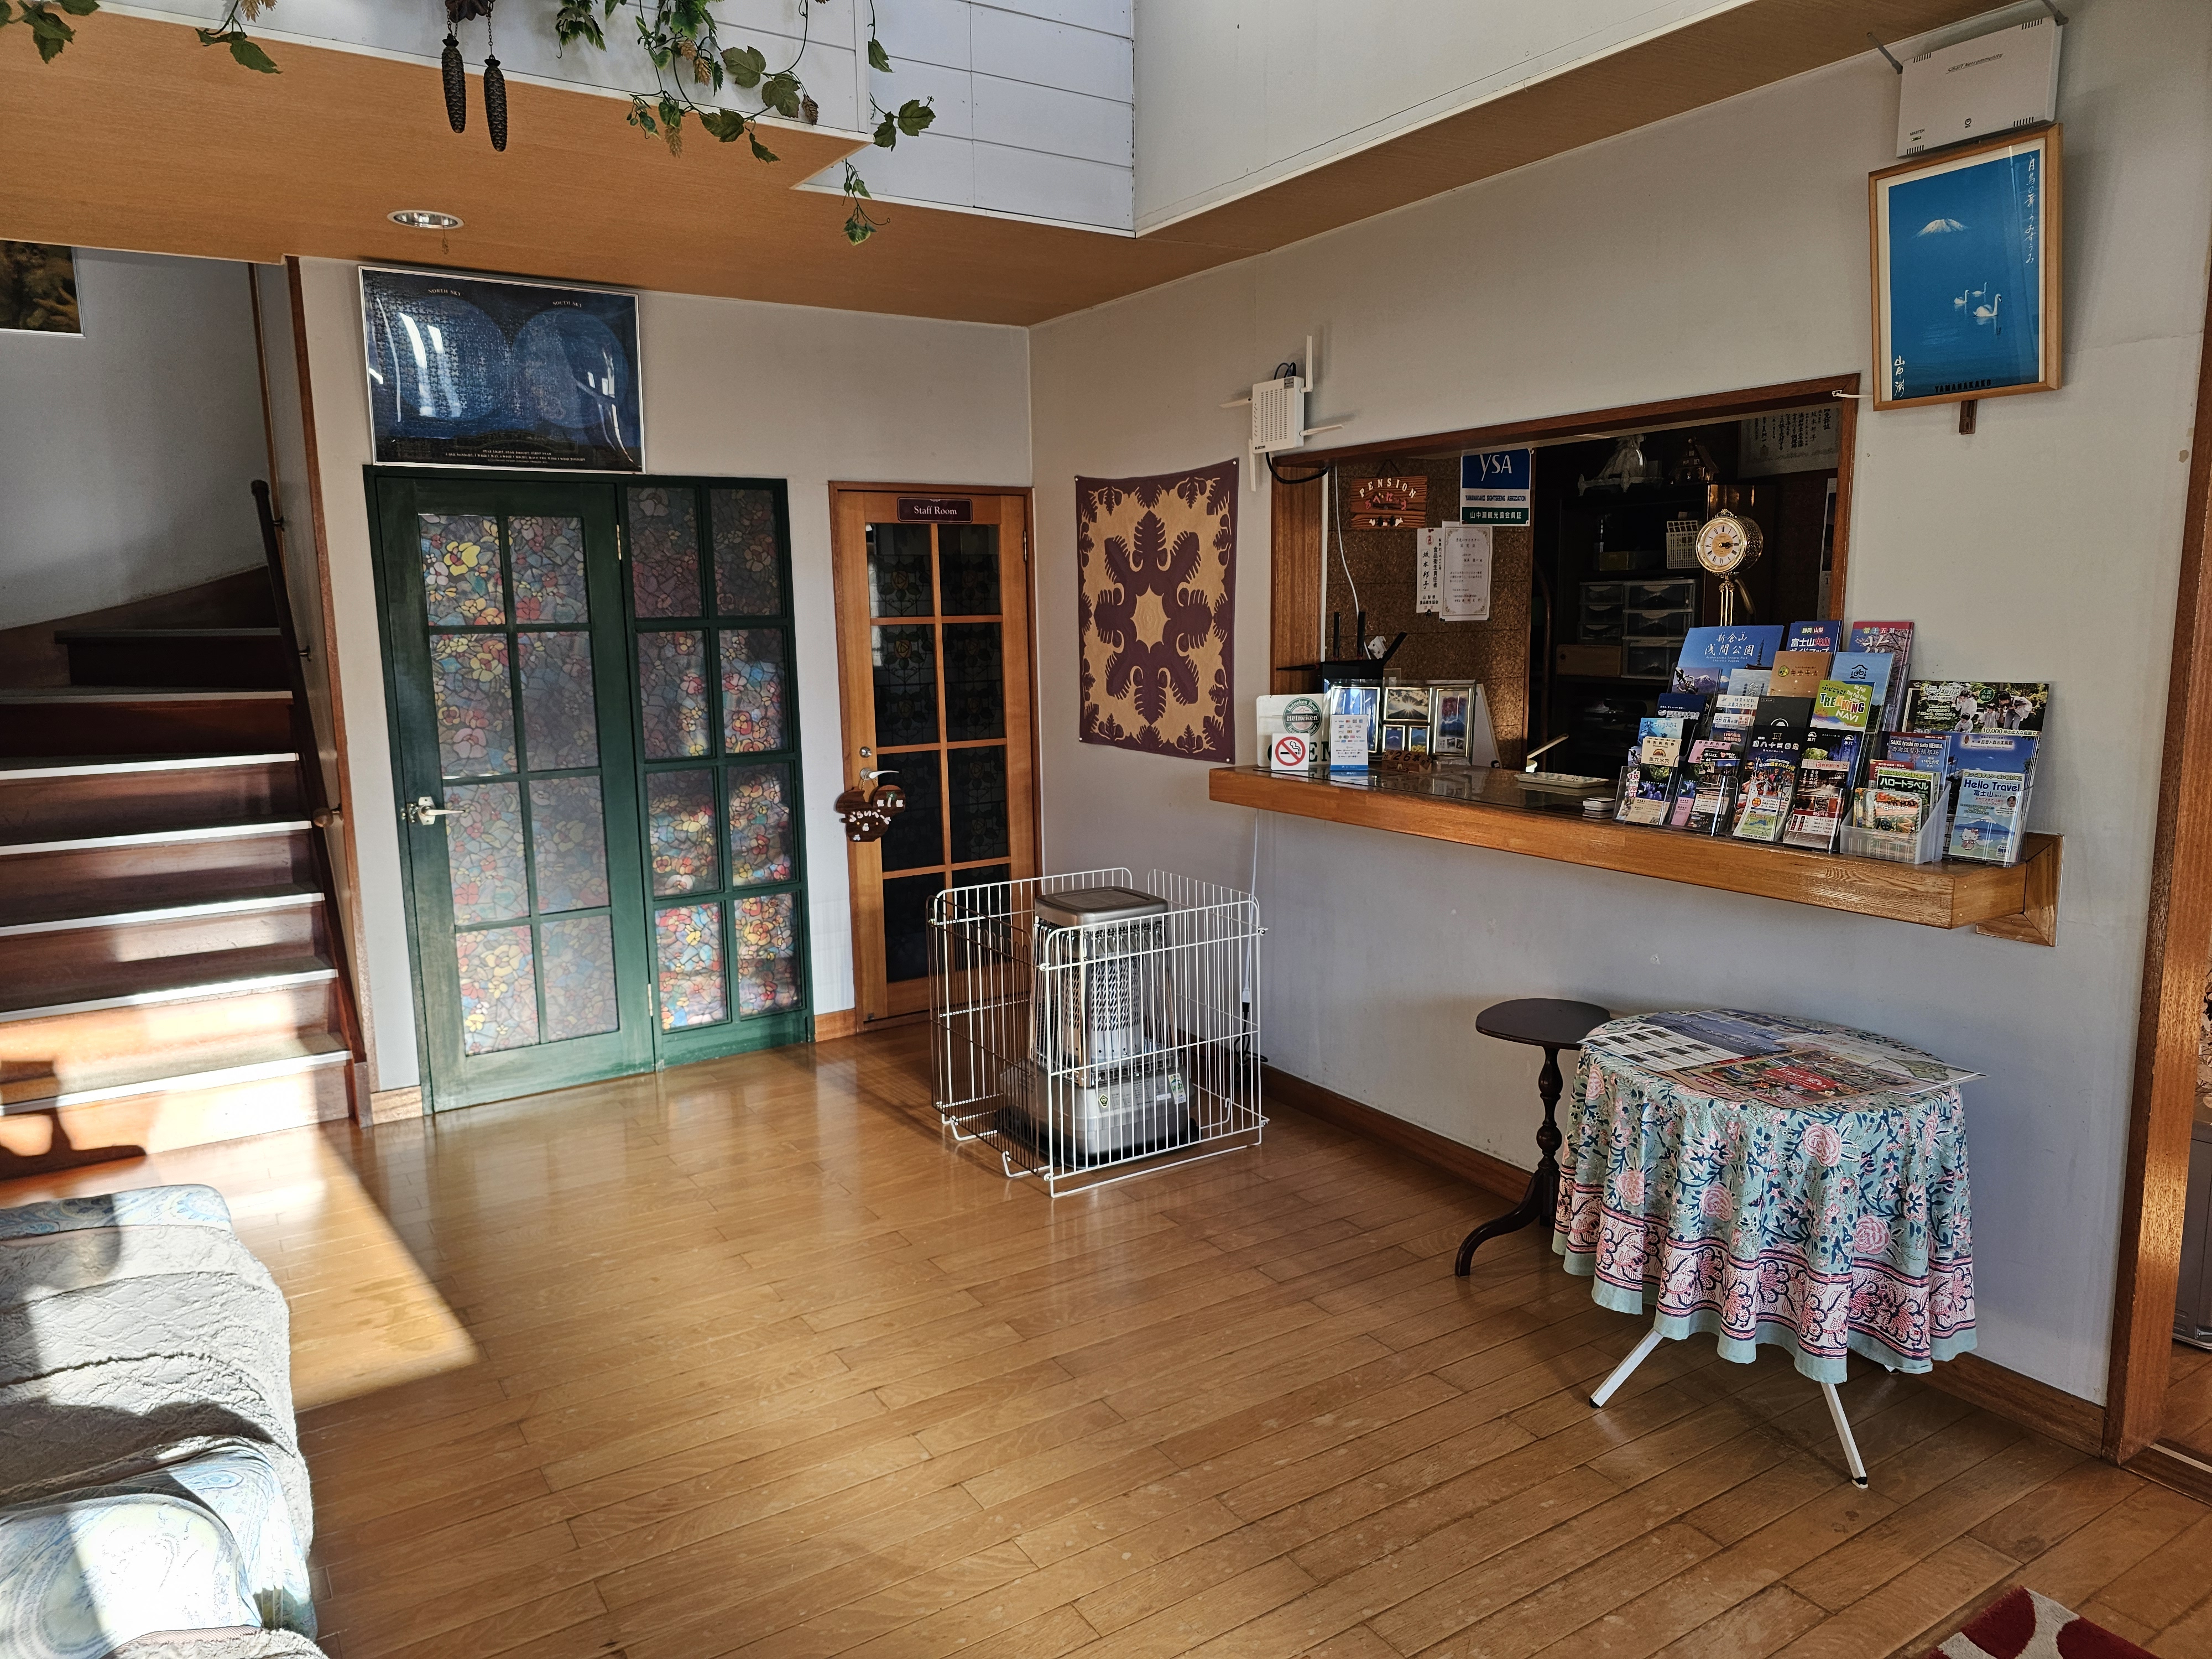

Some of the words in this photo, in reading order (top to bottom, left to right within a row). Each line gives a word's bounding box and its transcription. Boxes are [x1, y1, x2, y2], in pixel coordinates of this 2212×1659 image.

[1894, 355, 1905, 398] 山中湖
[1934, 379, 1991, 393] YAMANAKAKO
[1359, 478, 1416, 498] PENSION
[914, 505, 932, 514] Staff
[934, 506, 957, 515] Room
[1716, 633, 1747, 643] 新倉山
[1791, 637, 1830, 647] 富士山火山
[1705, 643, 1755, 656] 浅間公園
[1287, 700, 1308, 712] Heineken
[1308, 701, 1318, 711] Beer
[1820, 693, 1865, 713] TREKKING
[1835, 709, 1859, 722] NAVI
[1393, 752, 1412, 762] 26
[1412, 753, 1422, 762] 水
[1880, 778, 1929, 790] ハロートラベル
[1964, 779, 1989, 789] Hello
[1992, 781, 2020, 791] Travel
